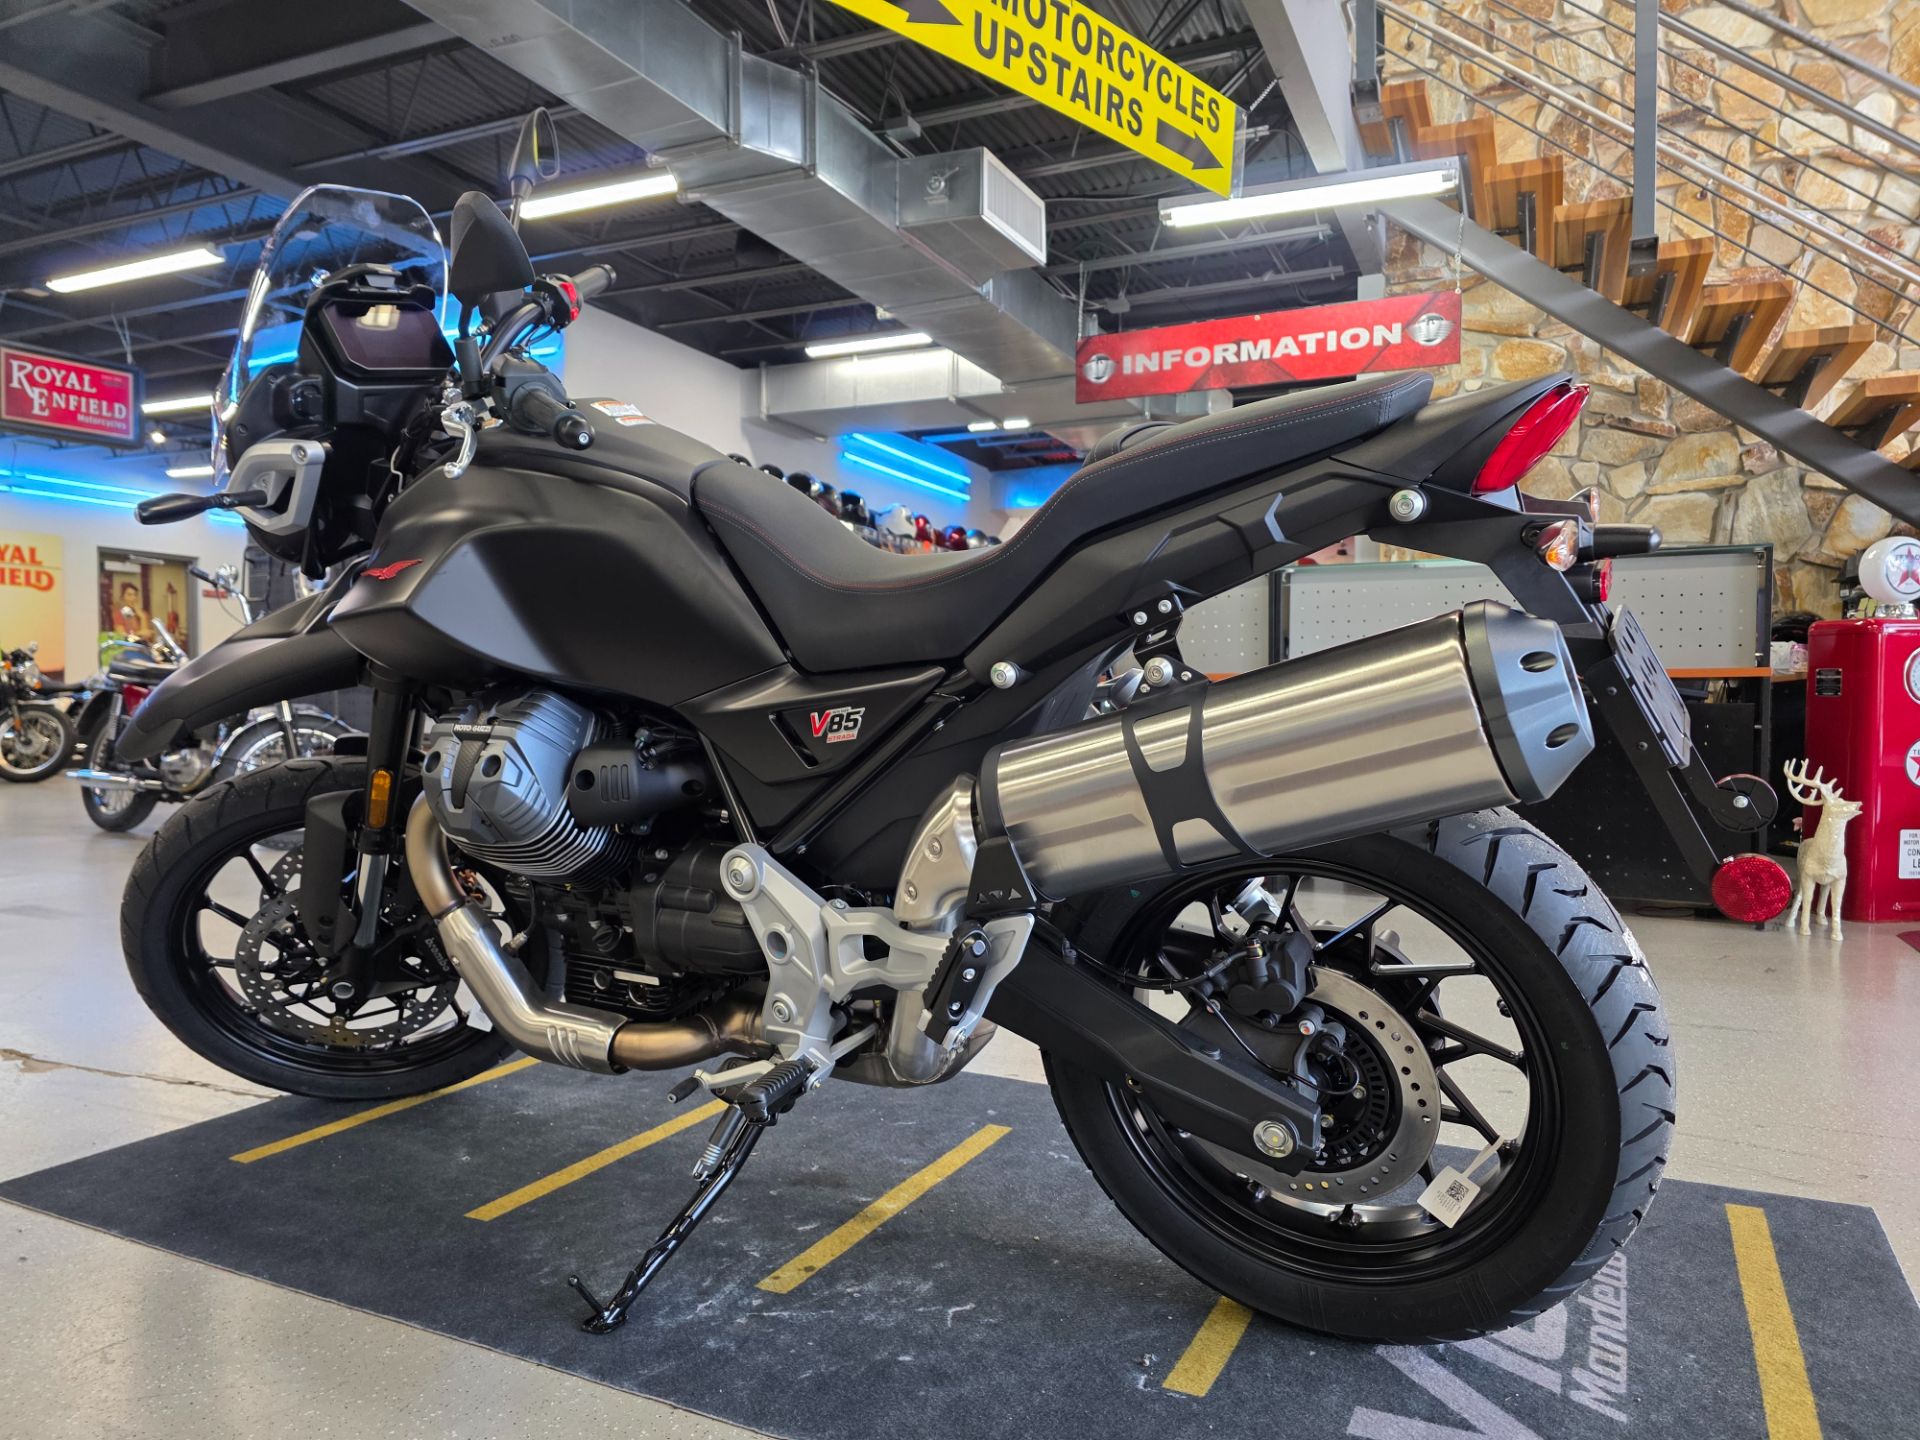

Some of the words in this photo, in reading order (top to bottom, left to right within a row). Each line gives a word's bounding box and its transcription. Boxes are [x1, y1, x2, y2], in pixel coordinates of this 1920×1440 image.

[974, 10, 1143, 137] UPSTAIRS
[1122, 322, 1402, 375] INFORMATION
[9, 358, 97, 396] ROYAL
[31, 387, 127, 419] ENFIELD
[810, 709, 863, 737] V85
